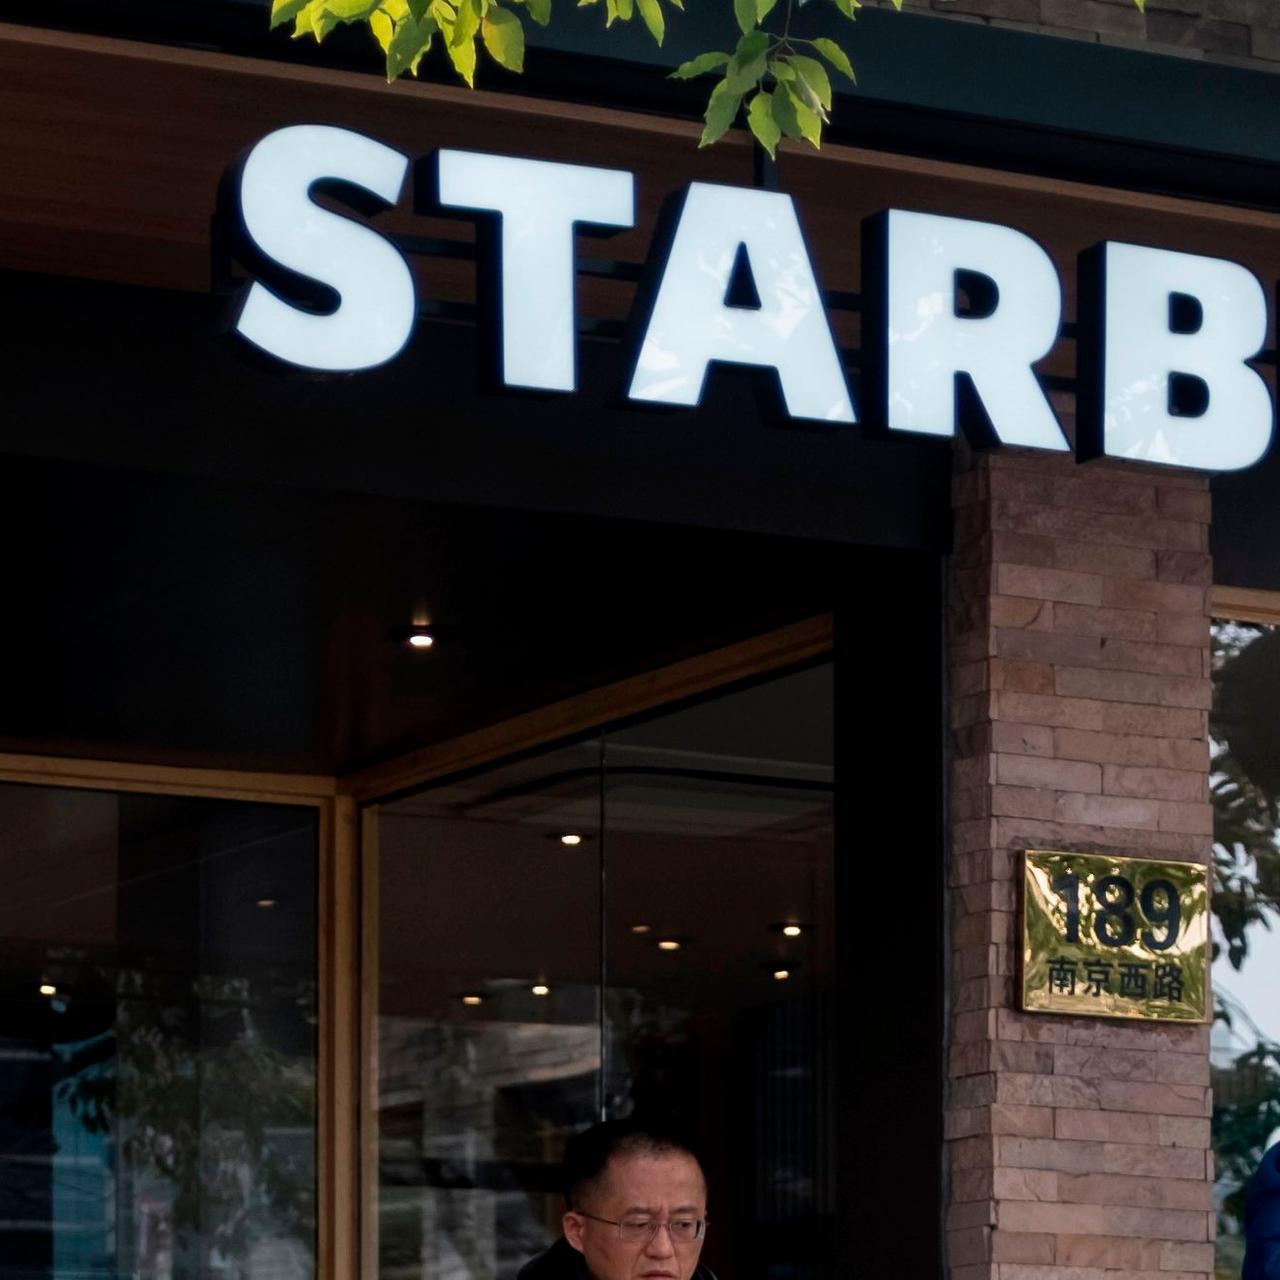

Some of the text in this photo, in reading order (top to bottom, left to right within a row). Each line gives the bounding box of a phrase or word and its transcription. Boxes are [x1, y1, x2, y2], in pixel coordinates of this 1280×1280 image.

[1053, 873, 1181, 951] 189
[1047, 956, 1185, 1003] 南京西路
